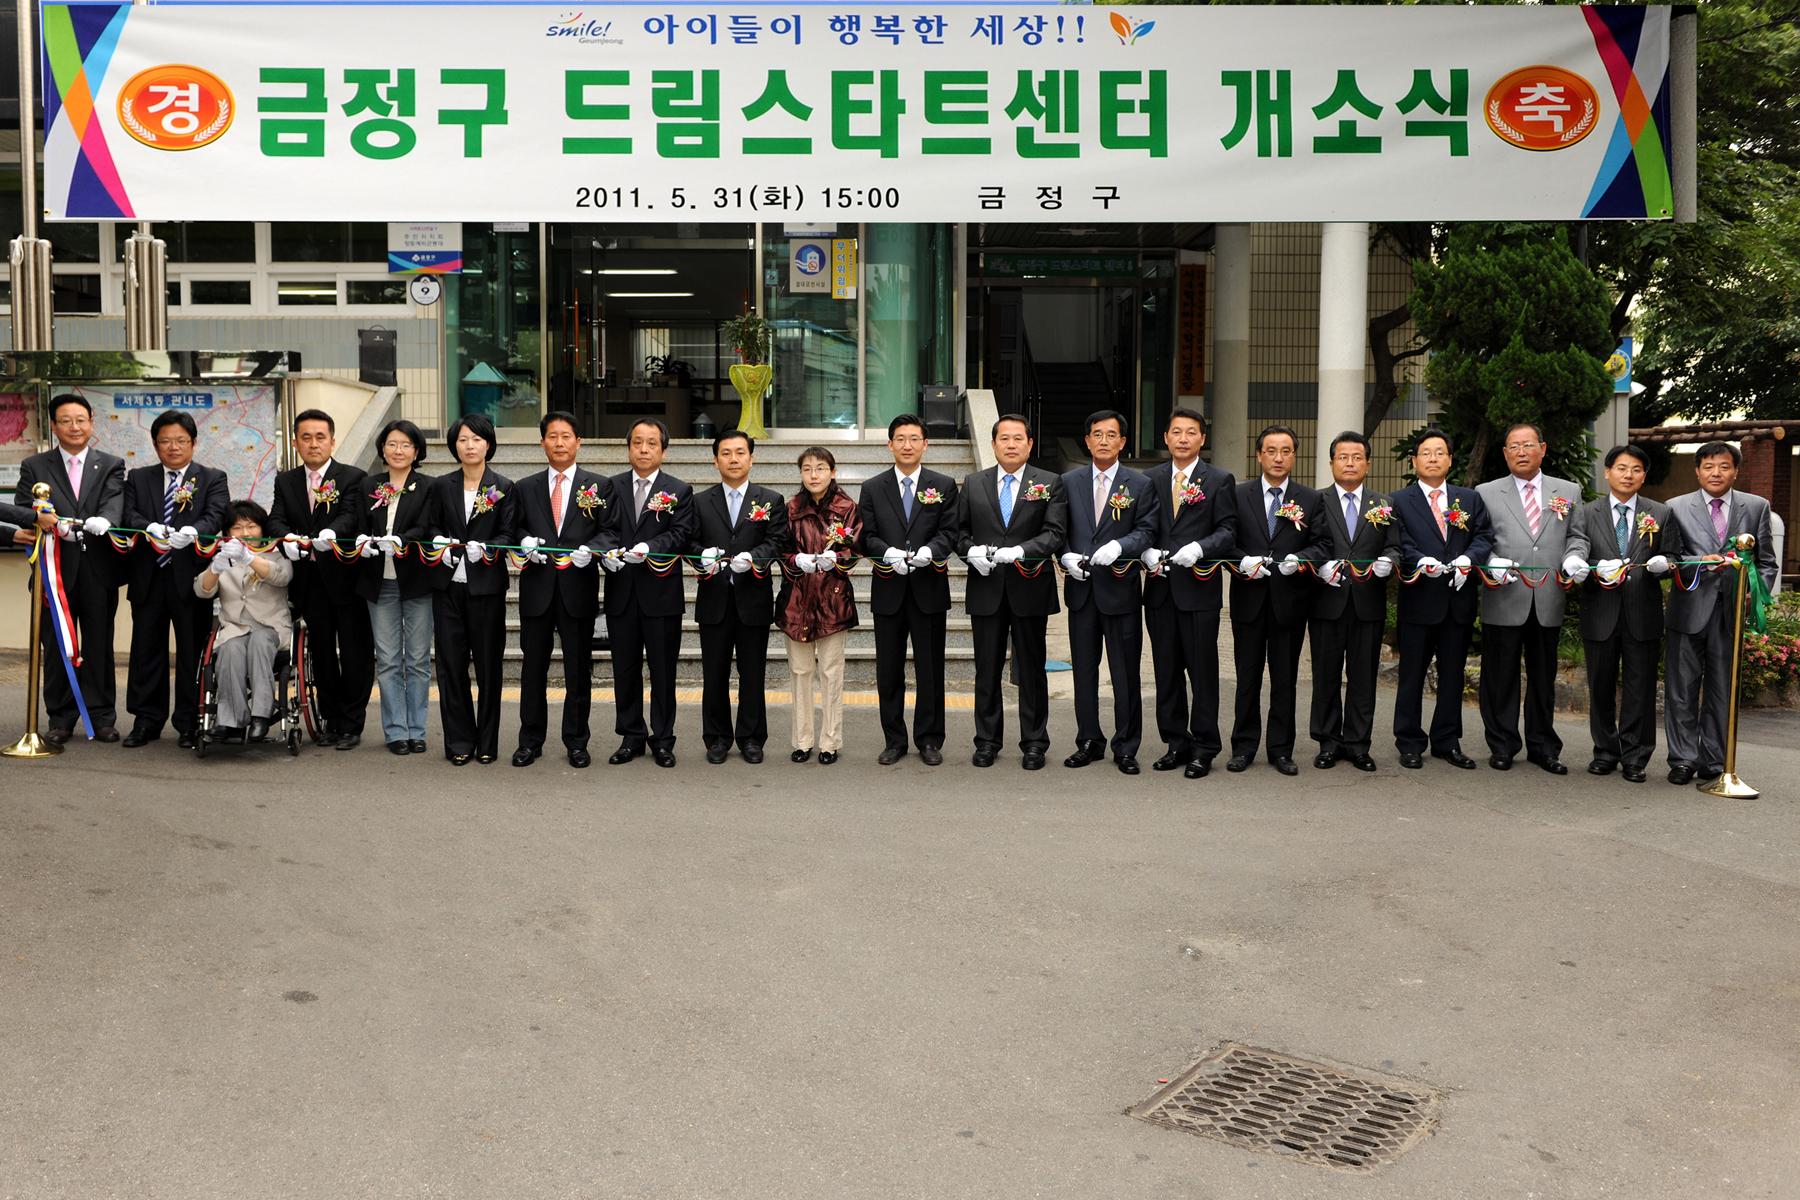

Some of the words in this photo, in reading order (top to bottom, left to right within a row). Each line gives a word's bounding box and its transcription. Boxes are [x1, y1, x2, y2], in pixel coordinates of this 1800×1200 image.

[546, 19, 612, 37] smile!
[643, 14, 803, 46] 아이들이
[828, 14, 949, 46] 행복한
[970, 14, 1086, 46] 세상!!
[147, 83, 200, 136] 경
[257, 67, 509, 161] 금정구
[562, 68, 1169, 160] 드림스타트센터
[1220, 68, 1470, 159] 개소식
[1514, 83, 1572, 134] 축
[576, 186, 655, 209] 2011.
[671, 186, 697, 209] 5.
[713, 184, 805, 211] 31(화)
[821, 186, 901, 209] 15:00
[421, 286, 430, 296] 9
[121, 394, 165, 407] 서제3동
[170, 394, 206, 407] 관내도
